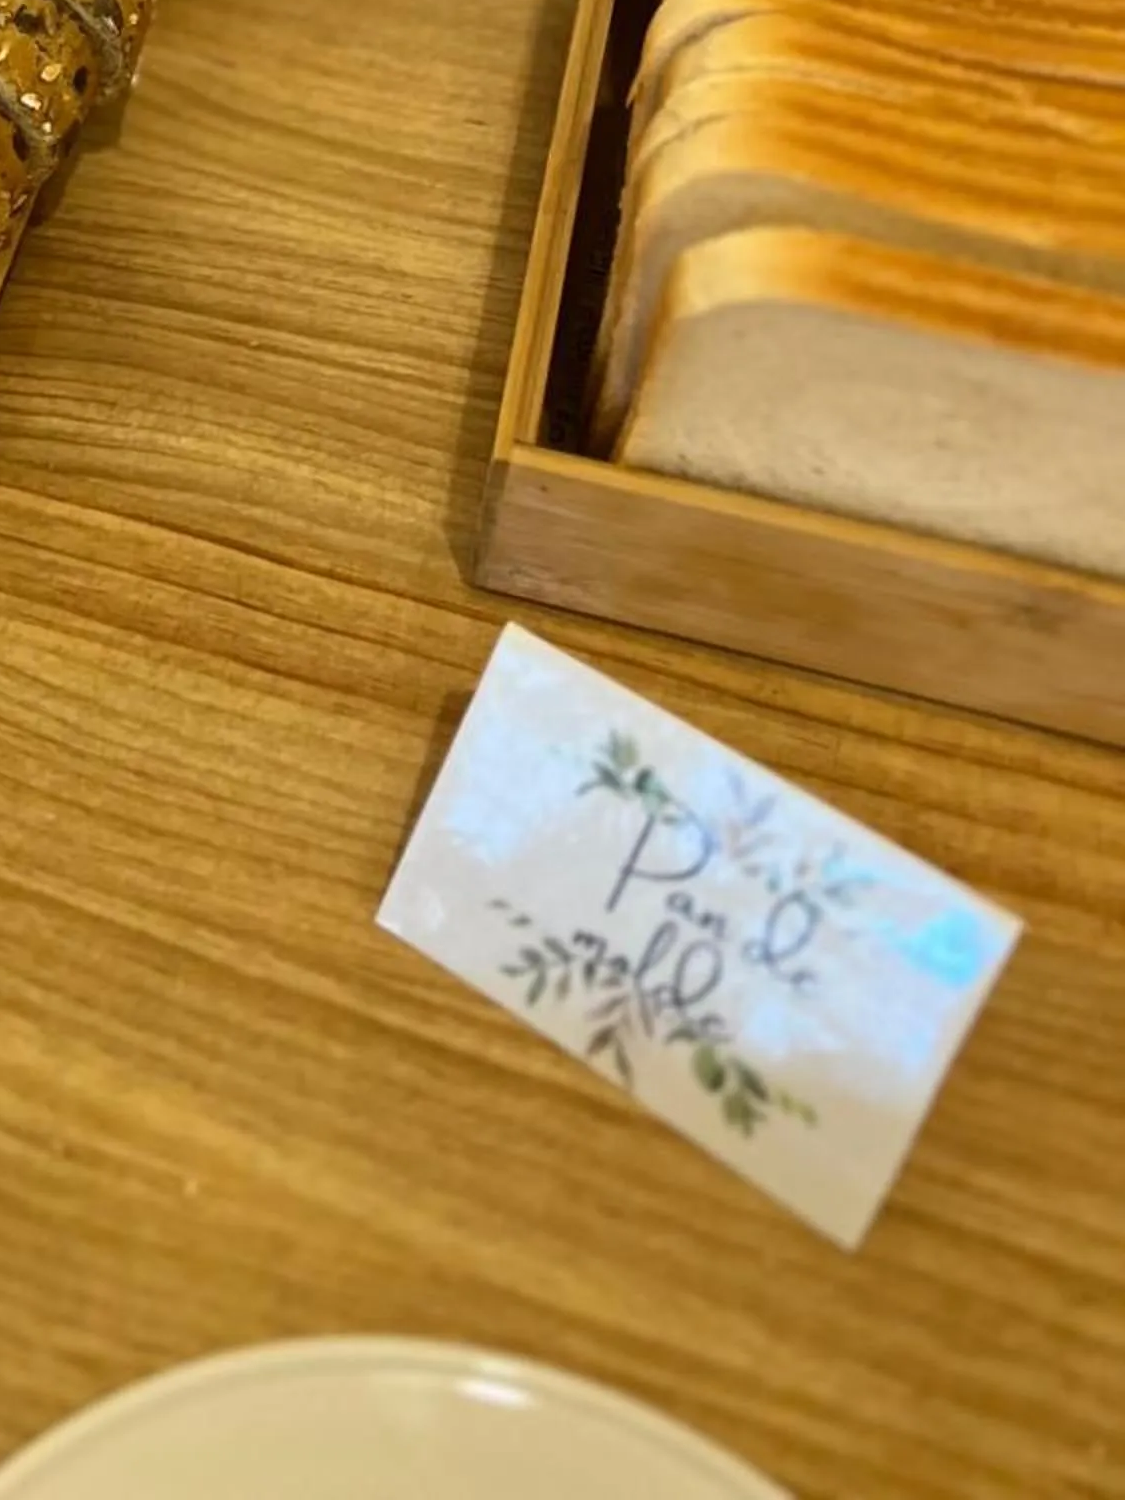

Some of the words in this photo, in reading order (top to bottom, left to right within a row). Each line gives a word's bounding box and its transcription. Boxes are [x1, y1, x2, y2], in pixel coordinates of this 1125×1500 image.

[604, 798, 727, 942] Pan
[741, 891, 821, 992] de
[572, 920, 727, 1036] molde
